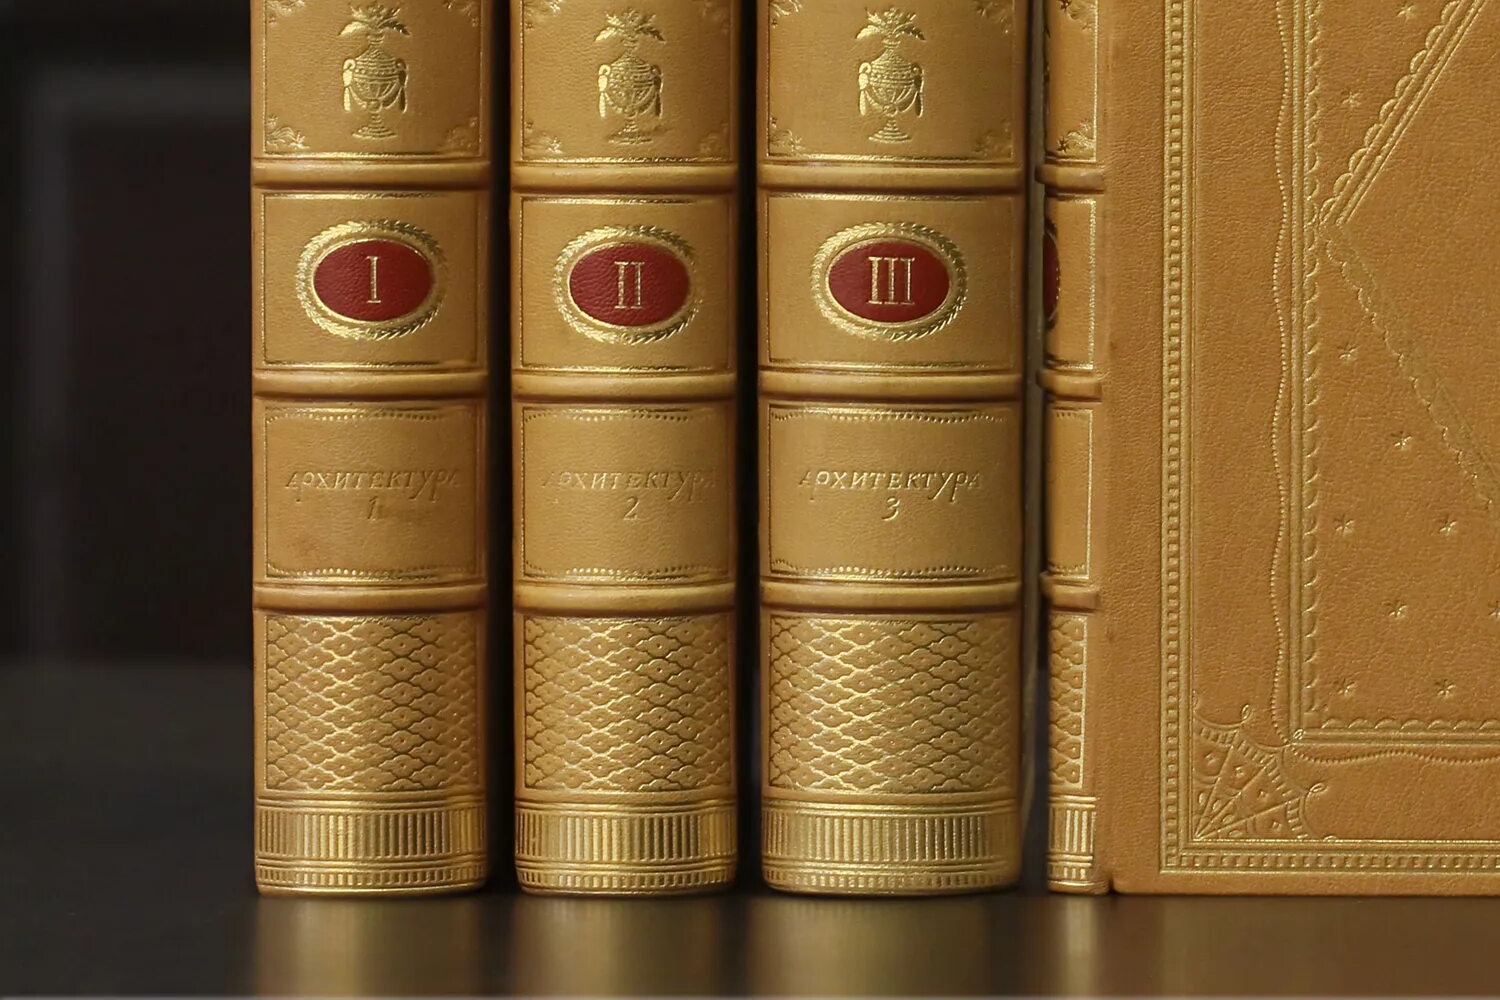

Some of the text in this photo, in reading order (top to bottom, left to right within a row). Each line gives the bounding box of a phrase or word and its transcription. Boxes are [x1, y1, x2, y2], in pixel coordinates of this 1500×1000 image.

[366, 255, 382, 304] I
[613, 261, 644, 310] II
[868, 256, 914, 305] III
[798, 468, 983, 503] АРХИТЕКТУРА
[367, 497, 380, 521] 1
[623, 497, 639, 520] 2
[881, 497, 901, 521] 3
